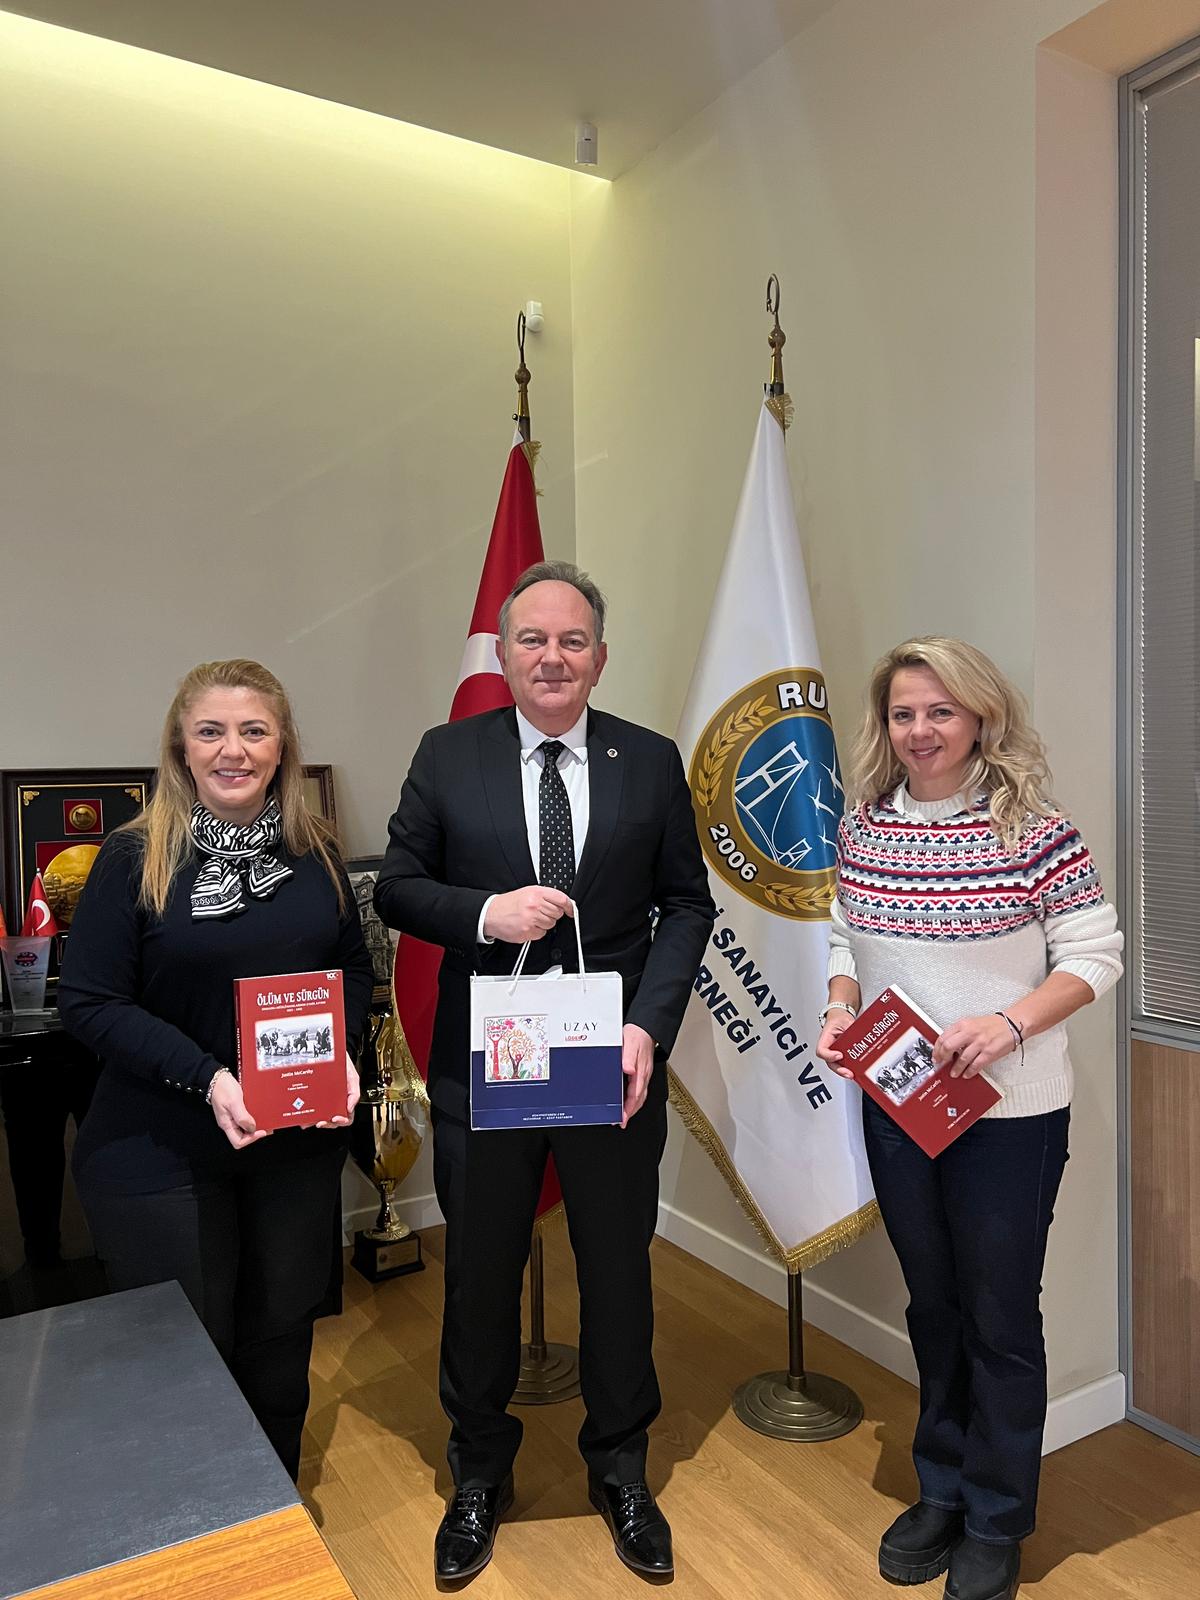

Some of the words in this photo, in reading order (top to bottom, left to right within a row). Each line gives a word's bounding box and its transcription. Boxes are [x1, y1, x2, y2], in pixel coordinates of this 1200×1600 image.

[708, 823, 759, 883] 2006
[256, 992, 282, 1006] ÖLÜM
[284, 993, 295, 1003] VE
[296, 987, 330, 1002] SÜRGÜN
[712, 927, 809, 1062] SANAYİCİ
[797, 1061, 833, 1110] VE
[563, 1022, 598, 1032] UZAY
[847, 1041, 868, 1060] ÖLÜM
[864, 1030, 877, 1043] VE
[873, 1009, 900, 1037] SÜRGÜN
